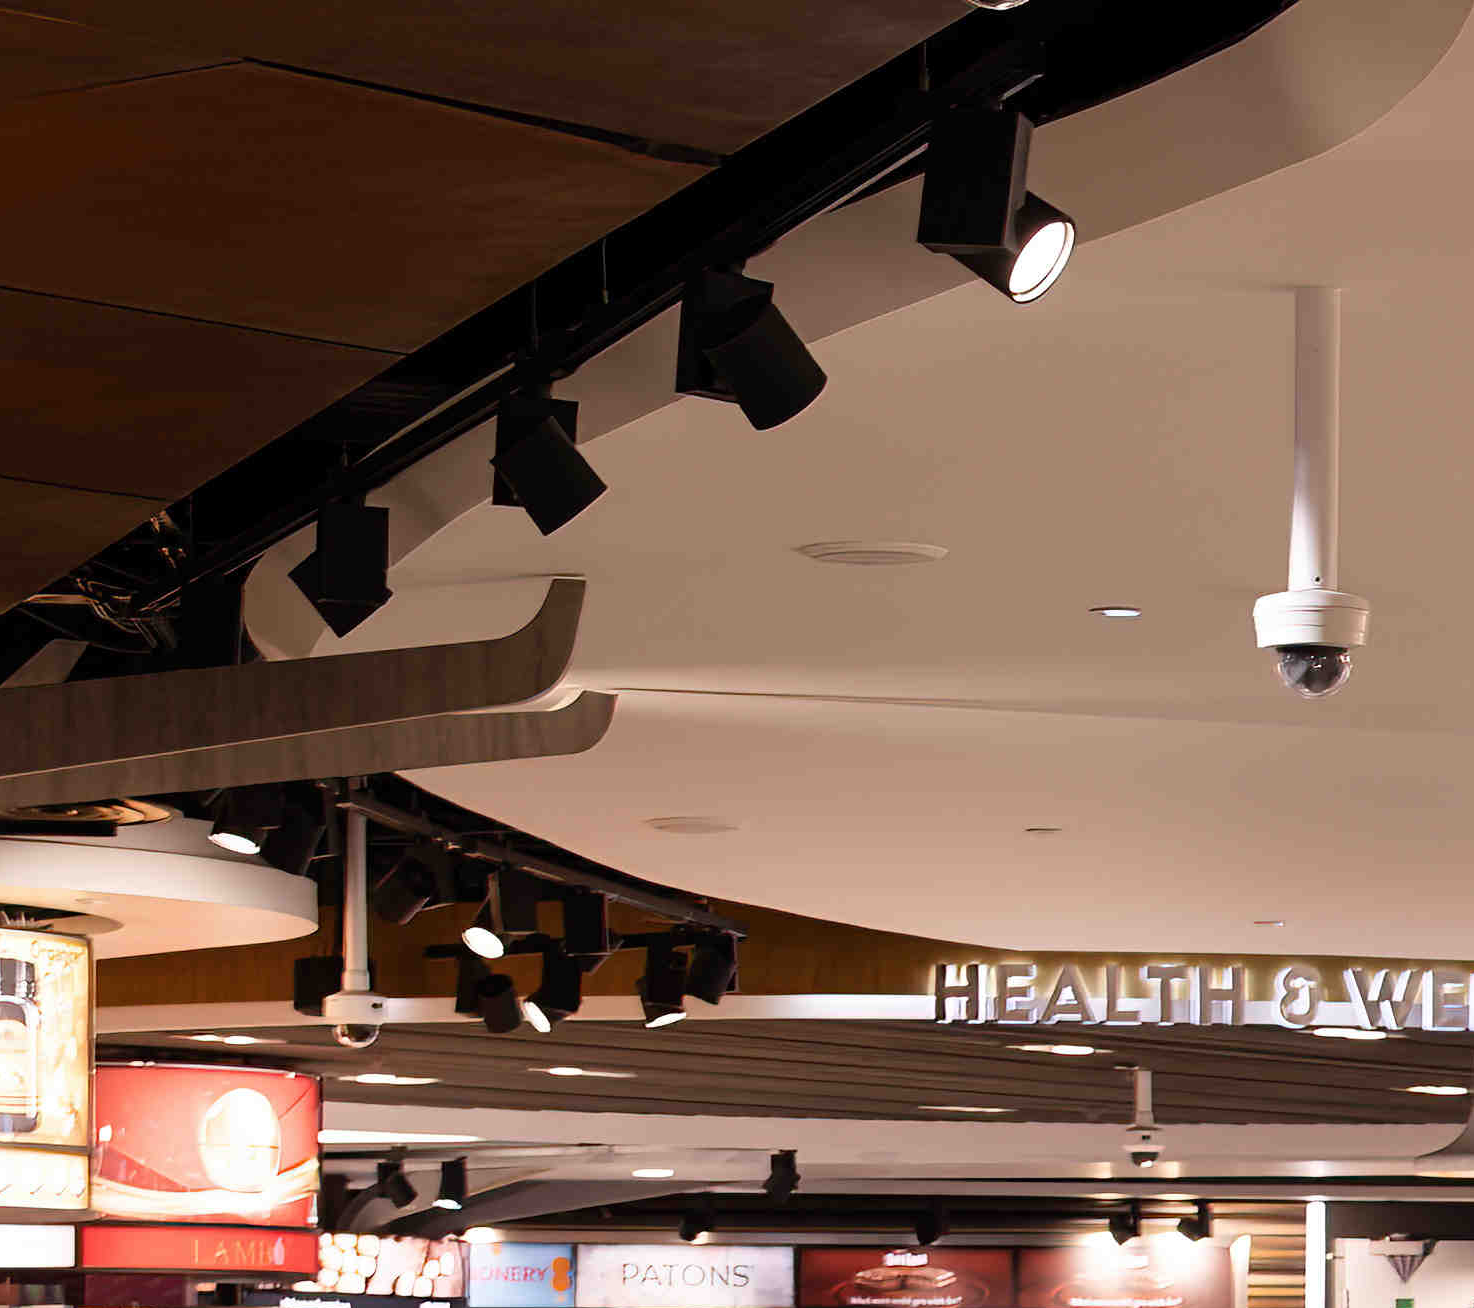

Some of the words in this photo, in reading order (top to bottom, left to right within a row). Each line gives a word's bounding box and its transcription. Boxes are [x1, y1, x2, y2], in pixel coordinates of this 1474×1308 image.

[934, 962, 1245, 1025] HEALTH
[1277, 975, 1322, 1028] &
[622, 1263, 752, 1288] PATONS
